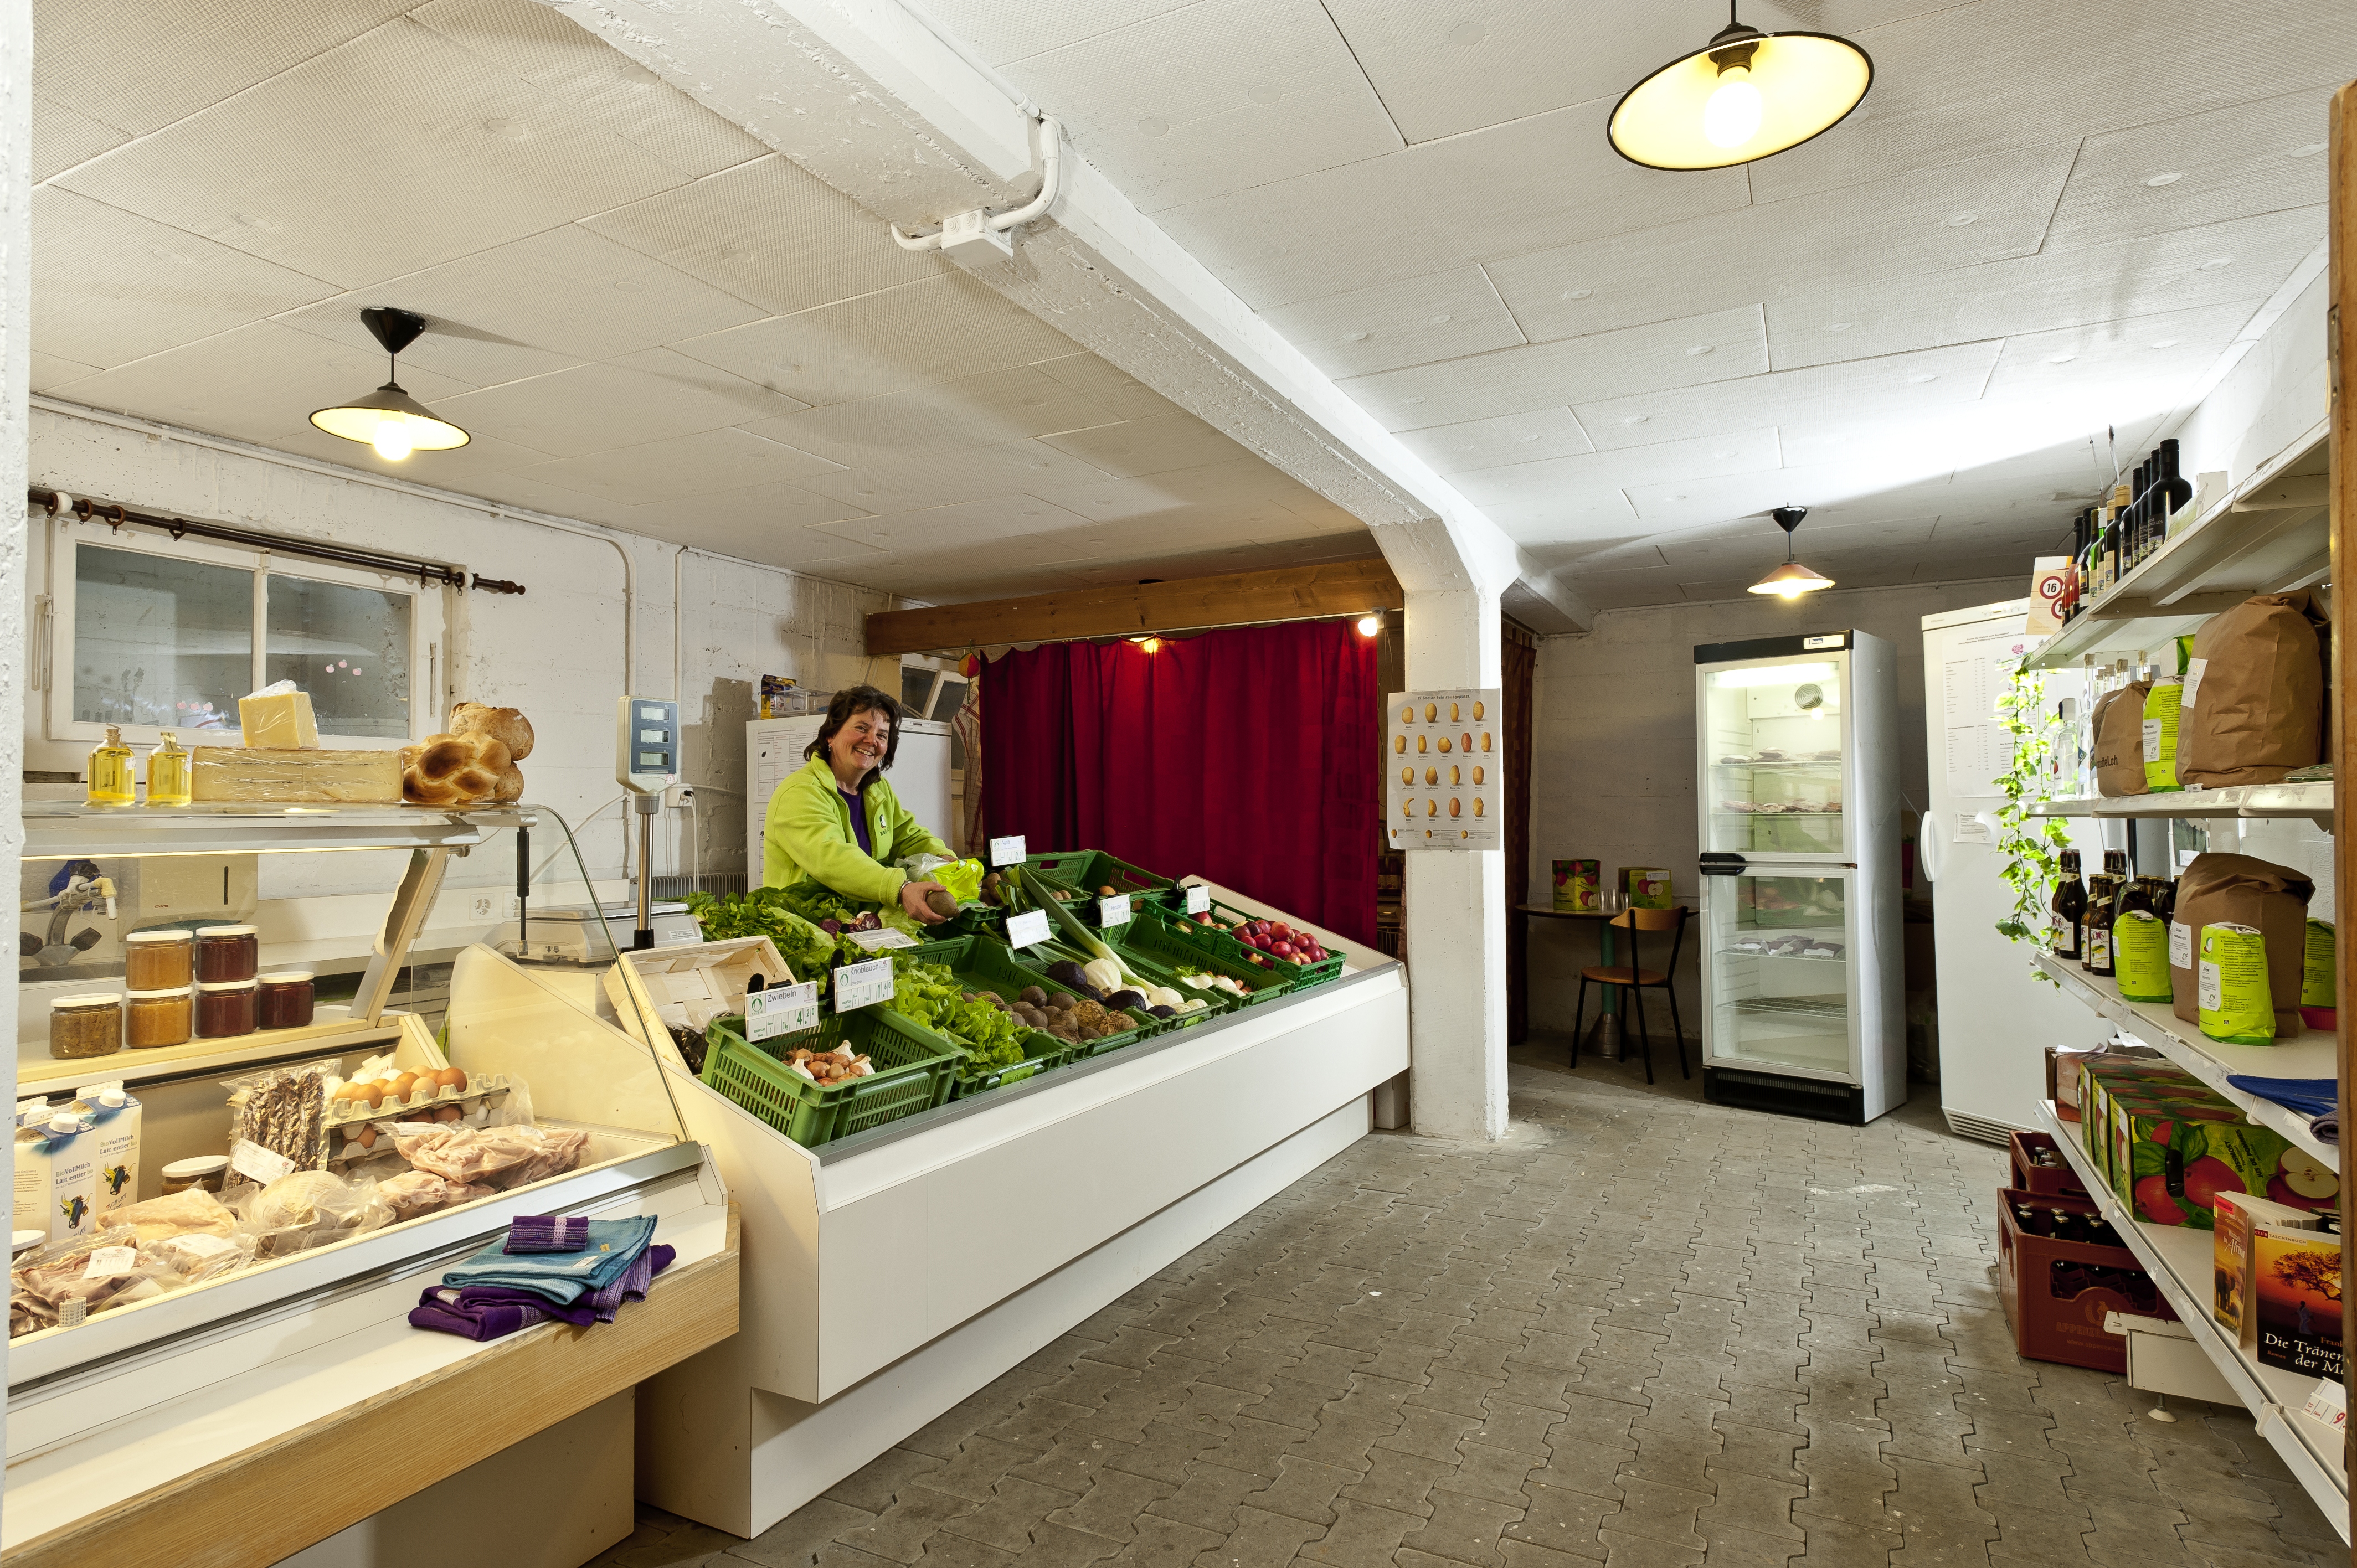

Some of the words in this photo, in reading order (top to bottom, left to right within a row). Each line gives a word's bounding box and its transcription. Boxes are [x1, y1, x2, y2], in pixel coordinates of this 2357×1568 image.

[2046, 583, 2056, 592] 16
[768, 990, 796, 1002] Zwiebeln
[100, 1135, 134, 1148] BioVollMilch
[2235, 1129, 2252, 1157] POMMES
[2224, 1141, 2244, 1173] SÜSSMOST
[2249, 1157, 2257, 1166] DE
[55, 1162, 90, 1178] BioVollMilch
[2254, 1167, 2263, 1178] JUS
[55, 1177, 68, 1185] Lait
[69, 1171, 86, 1180] entier
[2269, 1234, 2307, 1245] TASCHENBUCH
[2264, 1332, 2289, 1348] Die
[2294, 1340, 2344, 1362] Tränen
[2267, 1350, 2286, 1359] Roman
[2295, 1354, 2318, 1368] der
